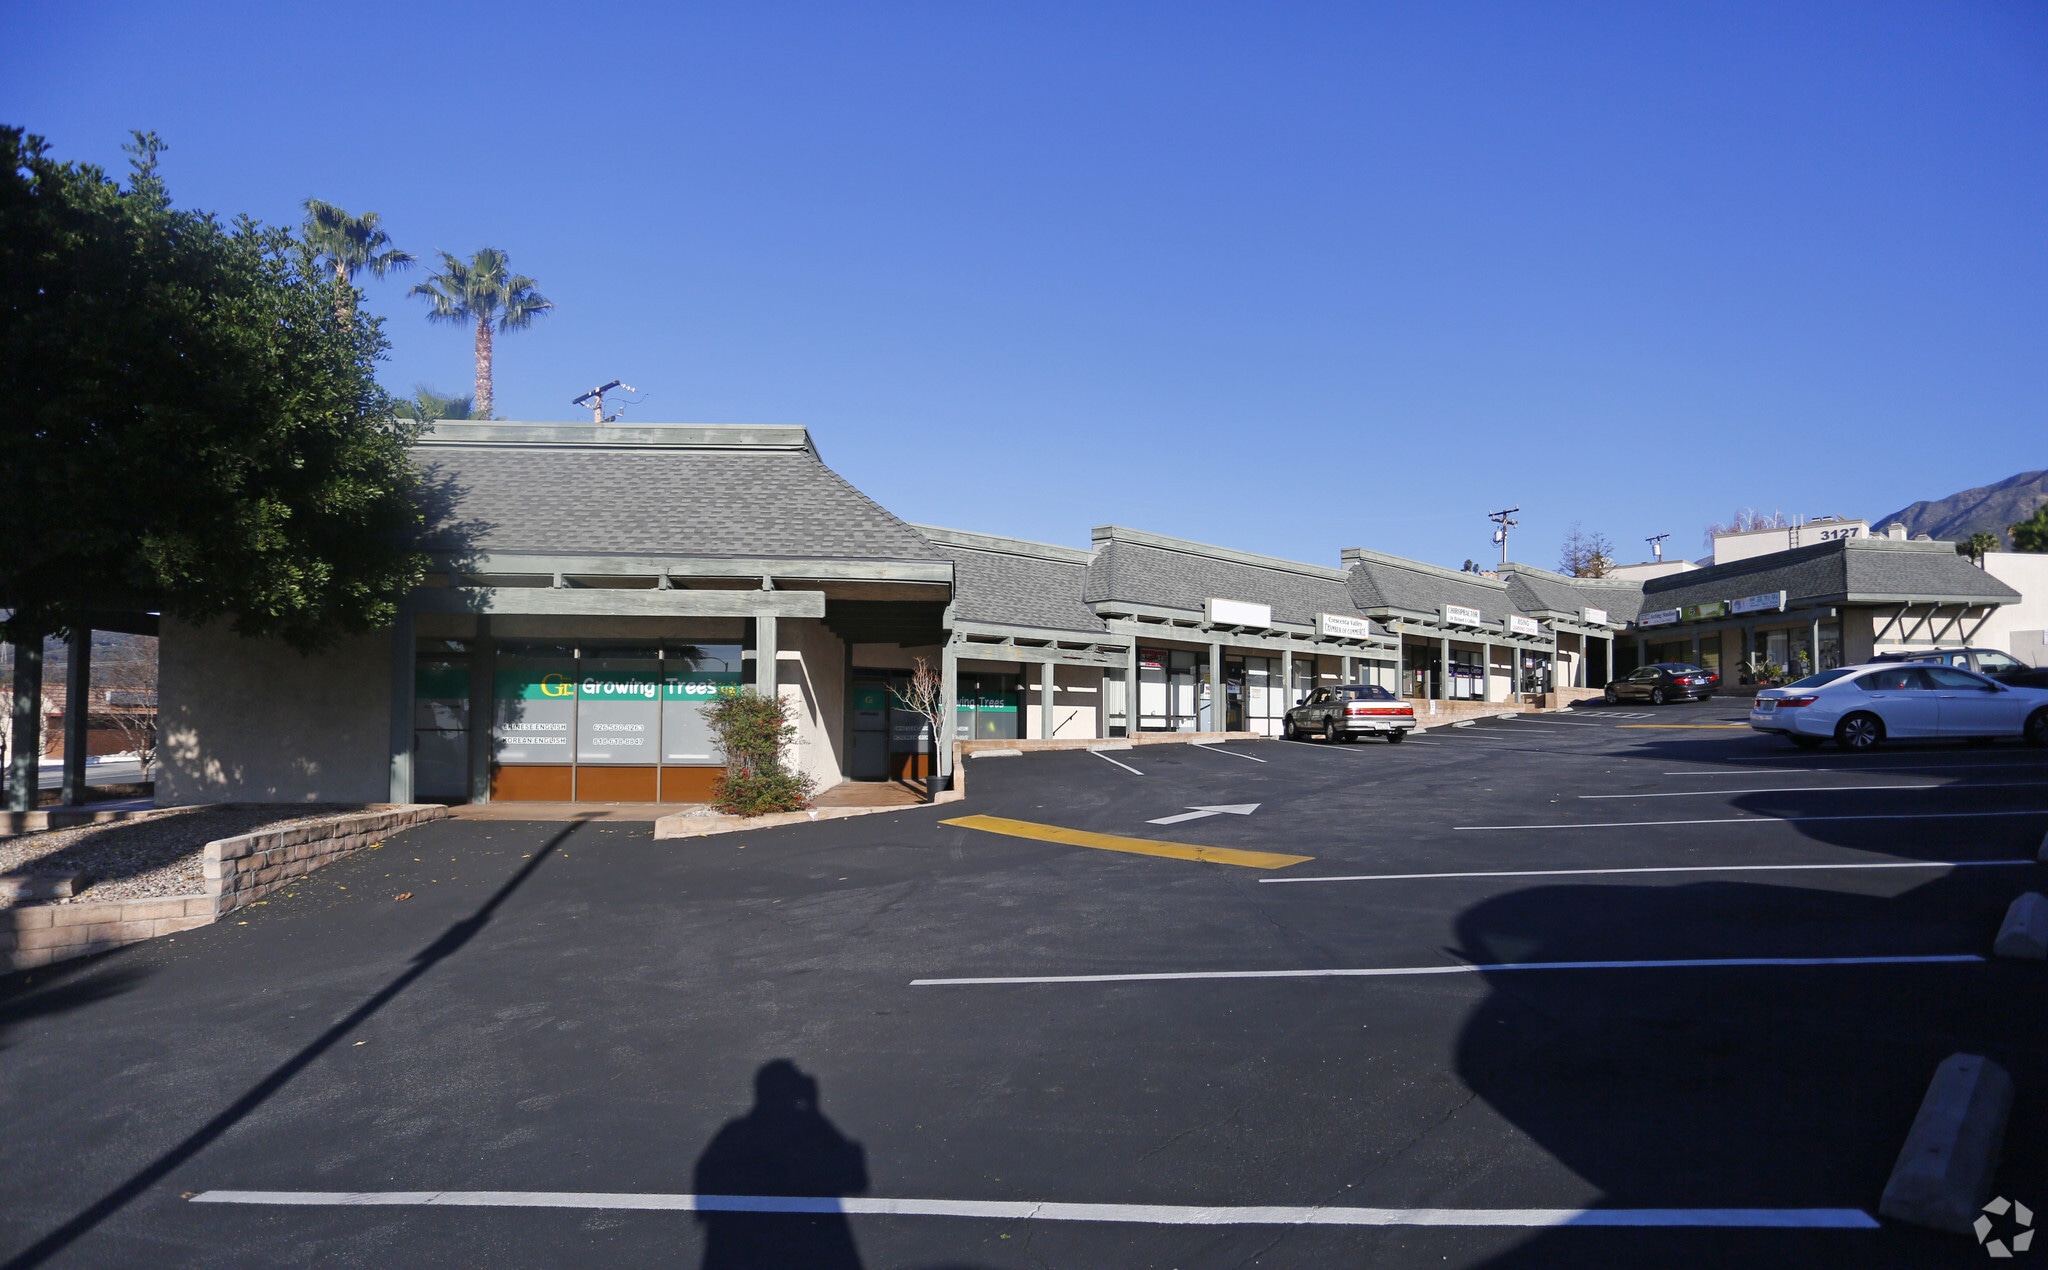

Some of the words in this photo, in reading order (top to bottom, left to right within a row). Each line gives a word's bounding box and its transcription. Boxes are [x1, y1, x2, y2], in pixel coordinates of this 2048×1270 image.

[1820, 527, 1859, 541] 3127
[1328, 616, 1350, 625] Crescenta
[1350, 620, 1363, 629] Valley
[1324, 622, 1342, 634] CHAMBER
[1347, 627, 1366, 637] COMMERCE
[582, 677, 655, 698] Growing
[665, 677, 718, 696] Trees
[978, 696, 1005, 708] Trees
[502, 723, 533, 731] CHINESE
[535, 723, 567, 731] ENGLISH
[502, 736, 533, 745] KOREAN
[534, 737, 567, 745] ENGLISH
